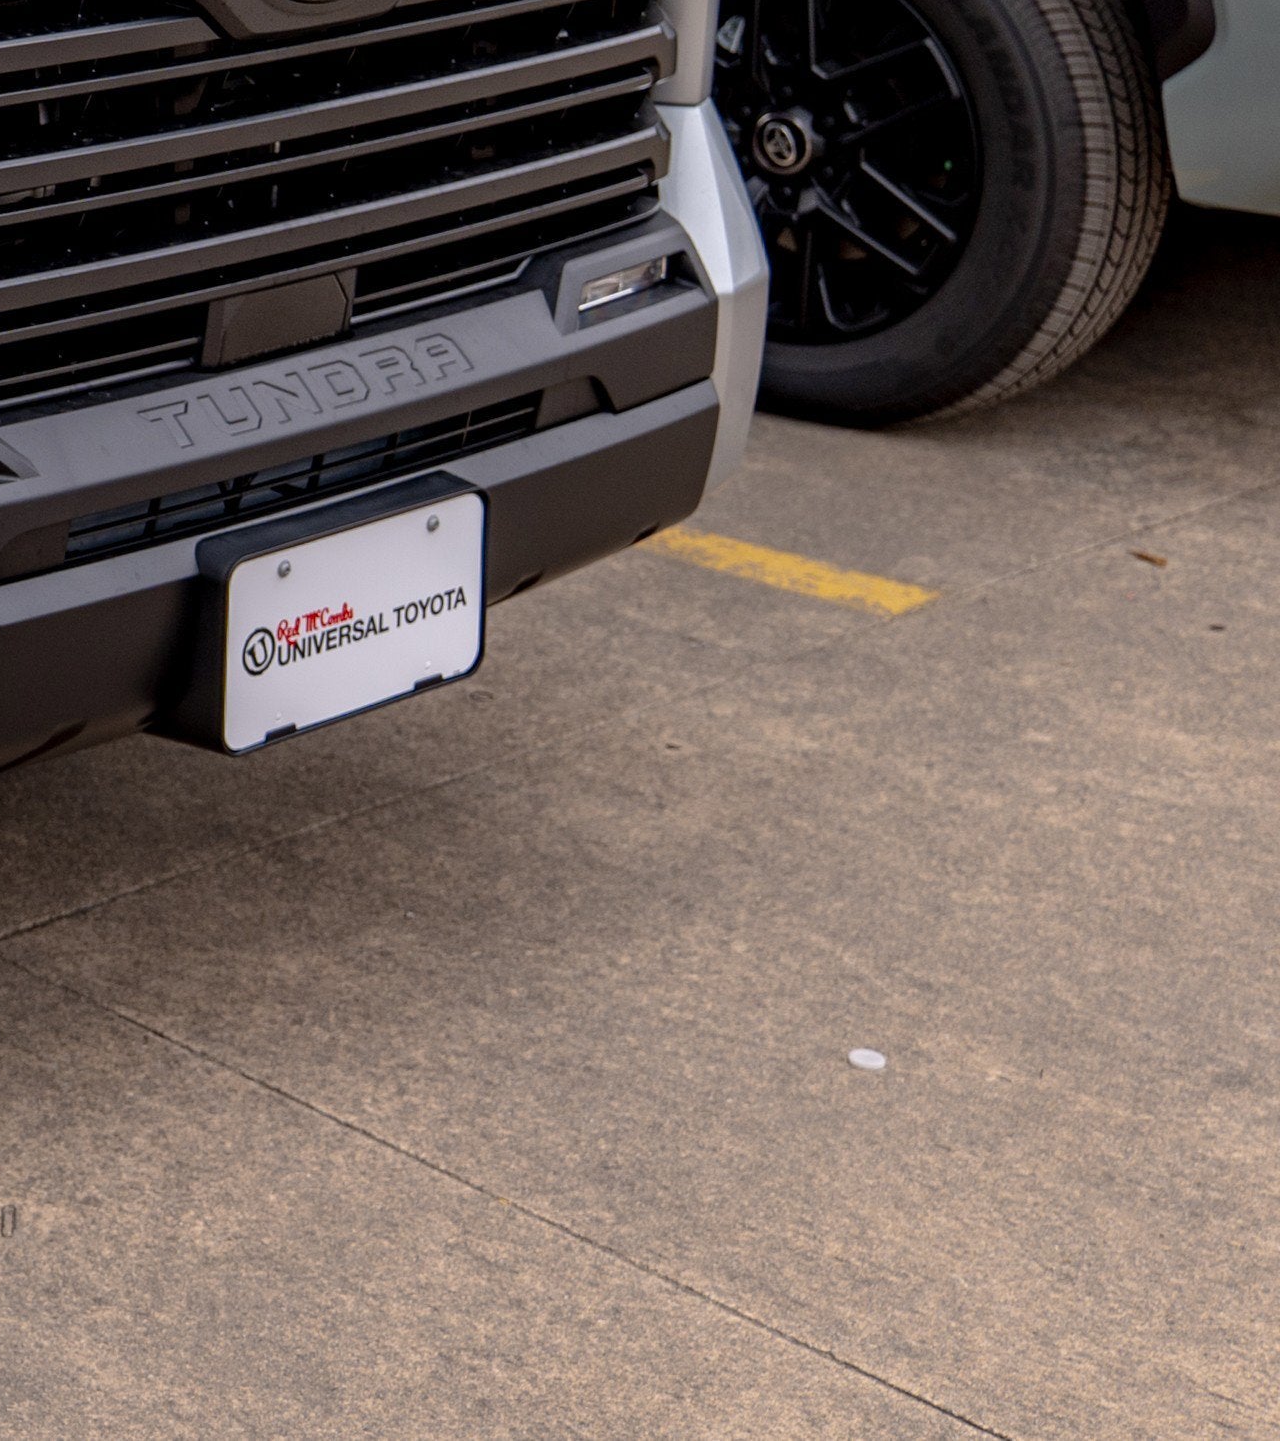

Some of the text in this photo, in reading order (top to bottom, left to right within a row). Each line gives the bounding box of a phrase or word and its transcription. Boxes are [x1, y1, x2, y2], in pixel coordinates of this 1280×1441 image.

[137, 332, 476, 449] TUNDRA
[276, 619, 300, 647] Red
[277, 586, 468, 666] UNIVERSAL TOYOTA
